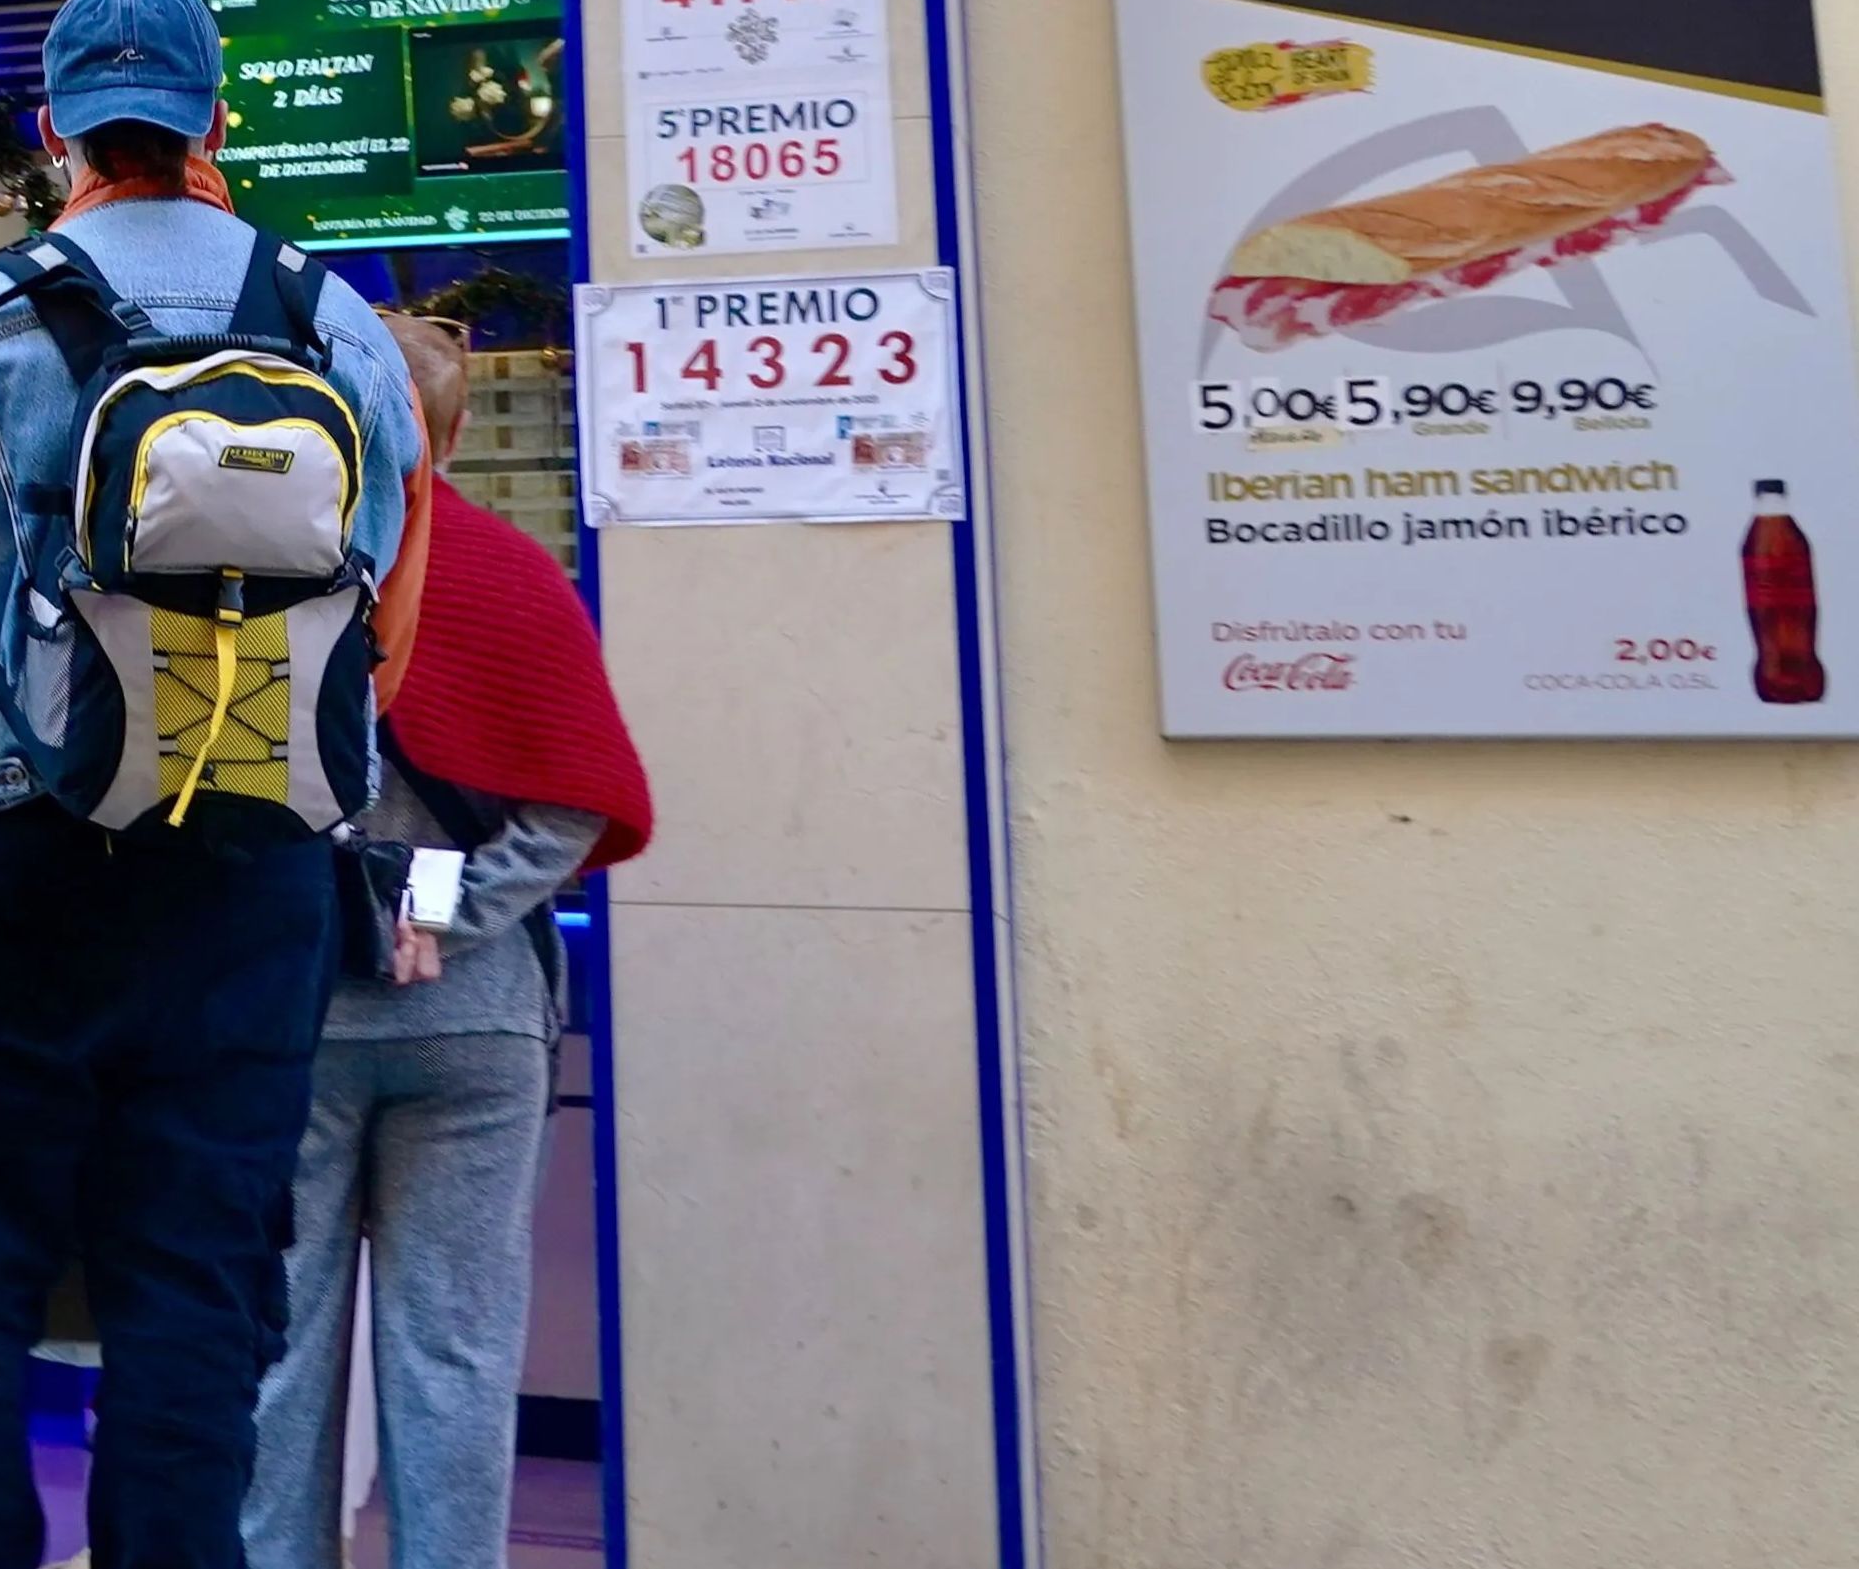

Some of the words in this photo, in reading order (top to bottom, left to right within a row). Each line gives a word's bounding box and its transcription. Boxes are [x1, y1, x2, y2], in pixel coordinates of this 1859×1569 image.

[369, 0, 403, 19] DE
[239, 59, 294, 81] SOLO
[294, 53, 375, 77] FALTAN
[273, 90, 288, 109] 2
[292, 84, 344, 108] DÍAS
[690, 98, 857, 138] PREMIO
[677, 139, 841, 184] 18065
[696, 286, 881, 329] PREMIO
[625, 329, 918, 394] 14323
[1510, 377, 1657, 421] 9,90€
[1206, 471, 1354, 503] Iberian
[1364, 466, 1461, 499] ham
[1470, 459, 1679, 496] sandwich
[1205, 512, 1392, 545] Bocadillo
[1402, 508, 1529, 546] jamón
[1542, 506, 1687, 538] ibérico
[1210, 620, 1361, 644] Disfrútalo
[1367, 623, 1425, 640] con
[1433, 621, 1467, 640] tu
